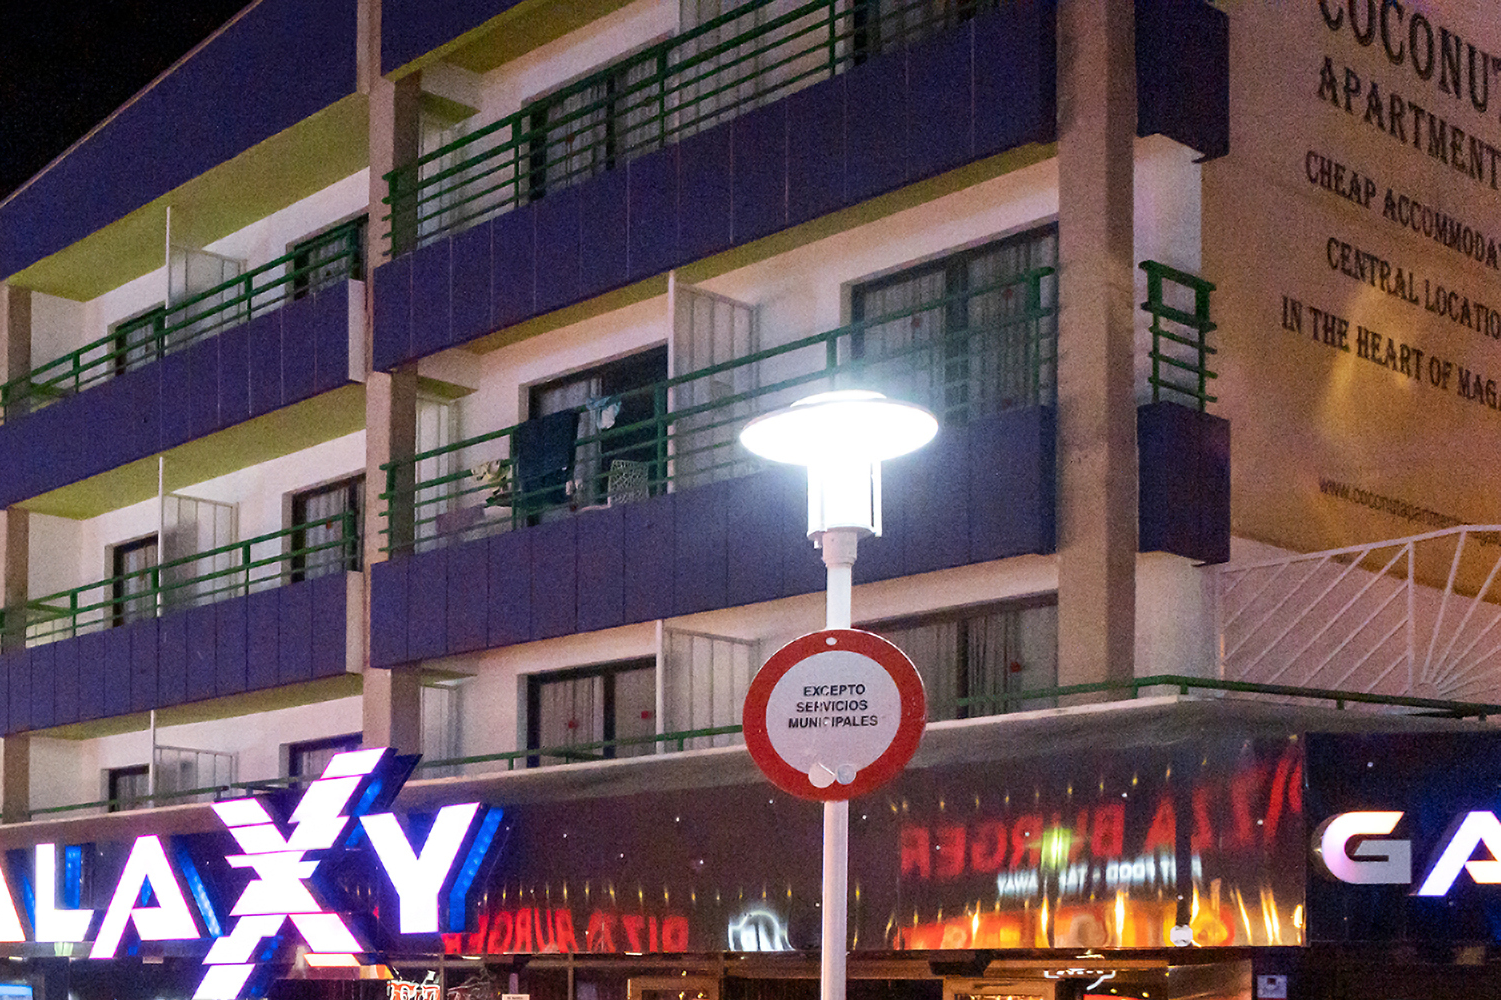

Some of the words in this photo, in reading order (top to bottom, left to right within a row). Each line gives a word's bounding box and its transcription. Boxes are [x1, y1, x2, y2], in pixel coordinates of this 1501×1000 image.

[1305, 150, 1376, 209] CHEAP
[1327, 237, 1419, 305] CENTRAL
[1282, 296, 1302, 334] IN
[1308, 306, 1350, 353] THE
[1357, 325, 1424, 380] HEART
[1429, 356, 1452, 390] OF
[796, 699, 868, 713] SERVICIOS
[803, 684, 866, 697] EXCEPTO
[788, 715, 878, 729] MUNICIPALES
